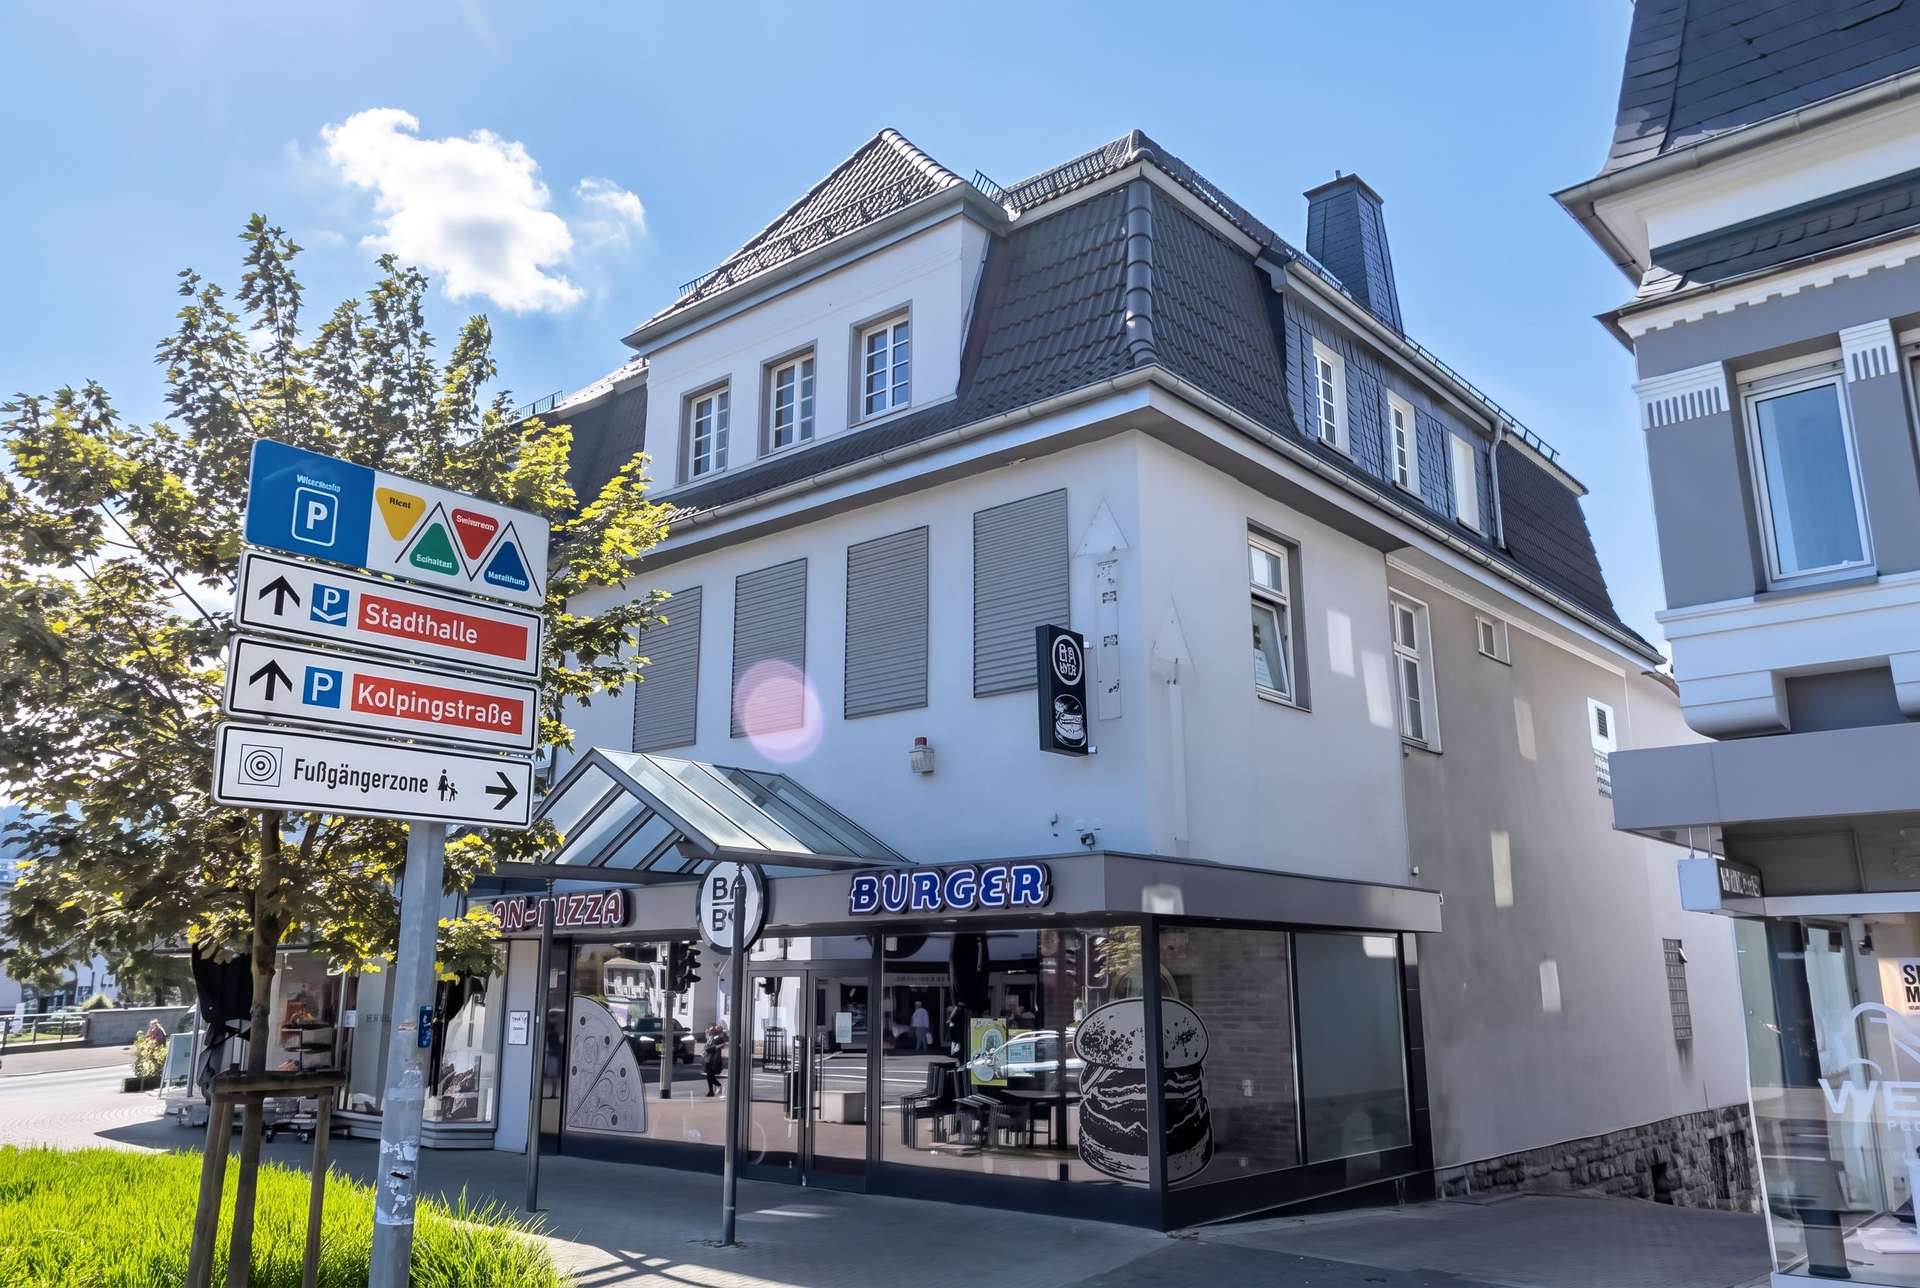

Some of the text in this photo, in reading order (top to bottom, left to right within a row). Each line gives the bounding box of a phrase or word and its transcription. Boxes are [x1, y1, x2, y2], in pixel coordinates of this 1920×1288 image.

[306, 501, 328, 530] P
[322, 588, 478, 644] P Stadthalle
[311, 672, 512, 726] P Kolpingstraße
[294, 758, 429, 793] Fußgängerzone
[851, 865, 1044, 912] BURGER
